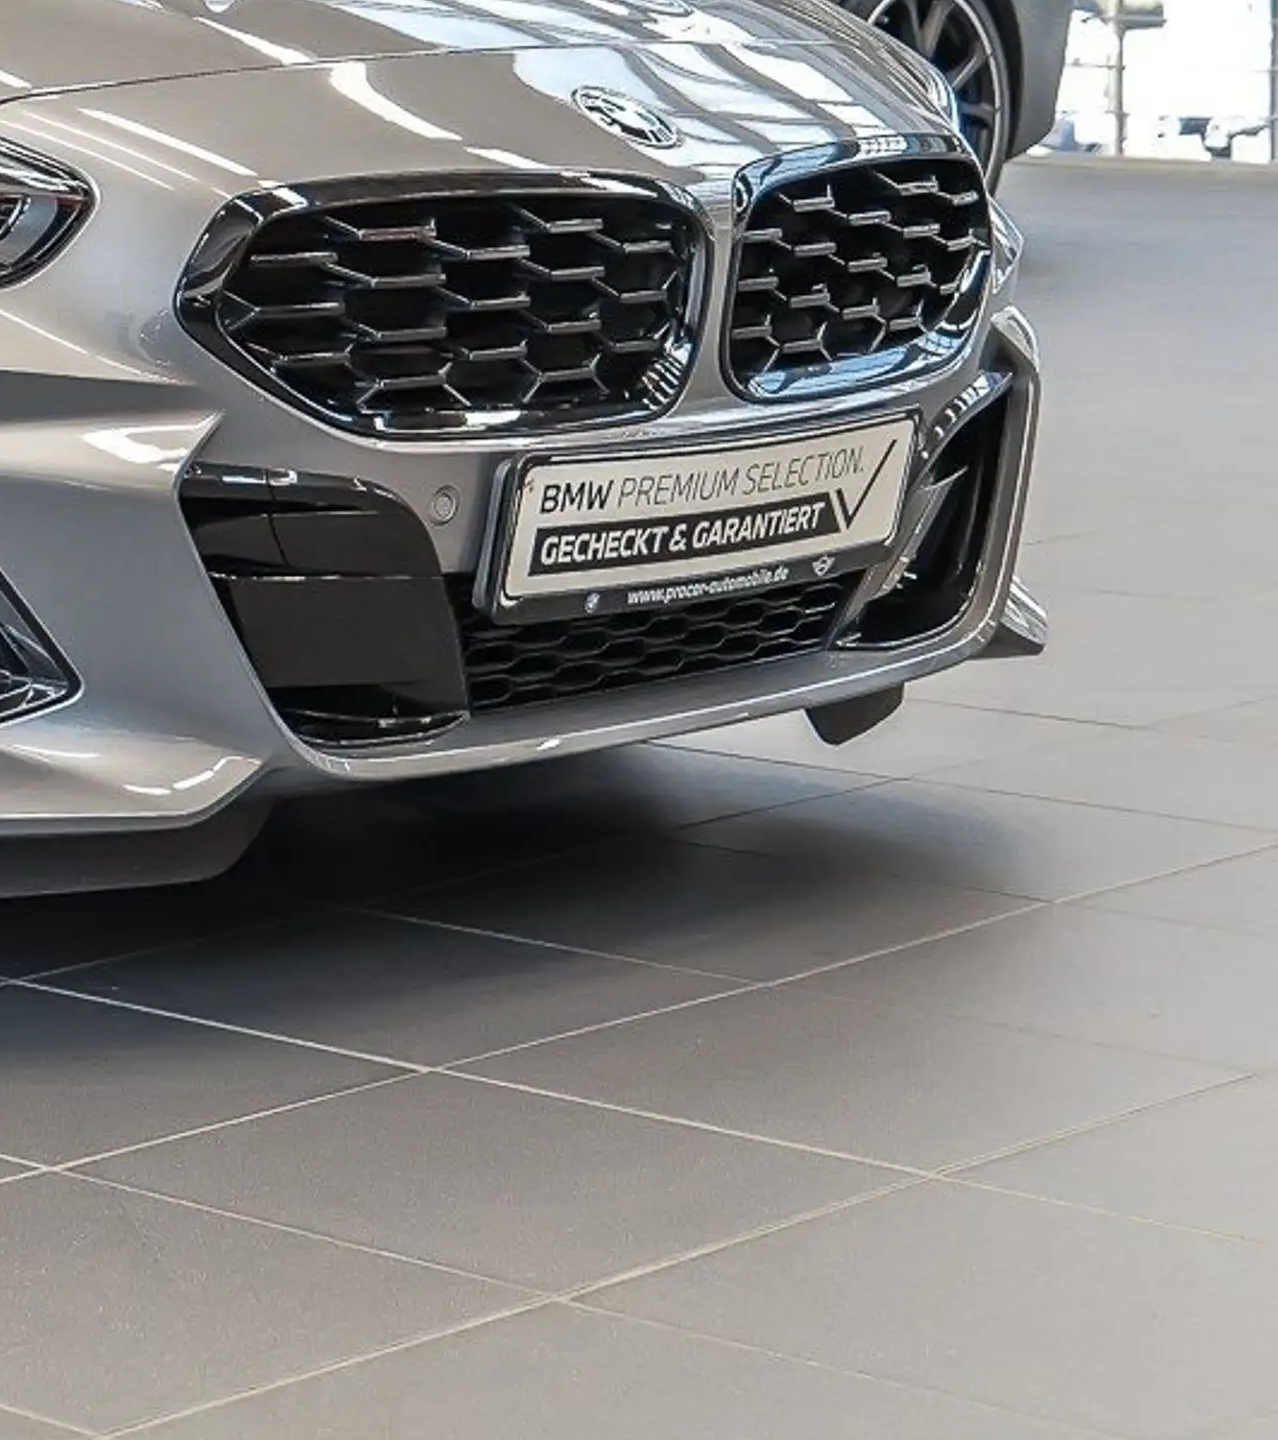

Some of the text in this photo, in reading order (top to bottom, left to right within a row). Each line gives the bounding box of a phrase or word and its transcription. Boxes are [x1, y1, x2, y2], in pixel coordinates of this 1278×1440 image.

[540, 480, 614, 514] BMW
[618, 467, 740, 508] PREMIUM
[541, 501, 826, 565] GECHECKT & GARANTIERT
